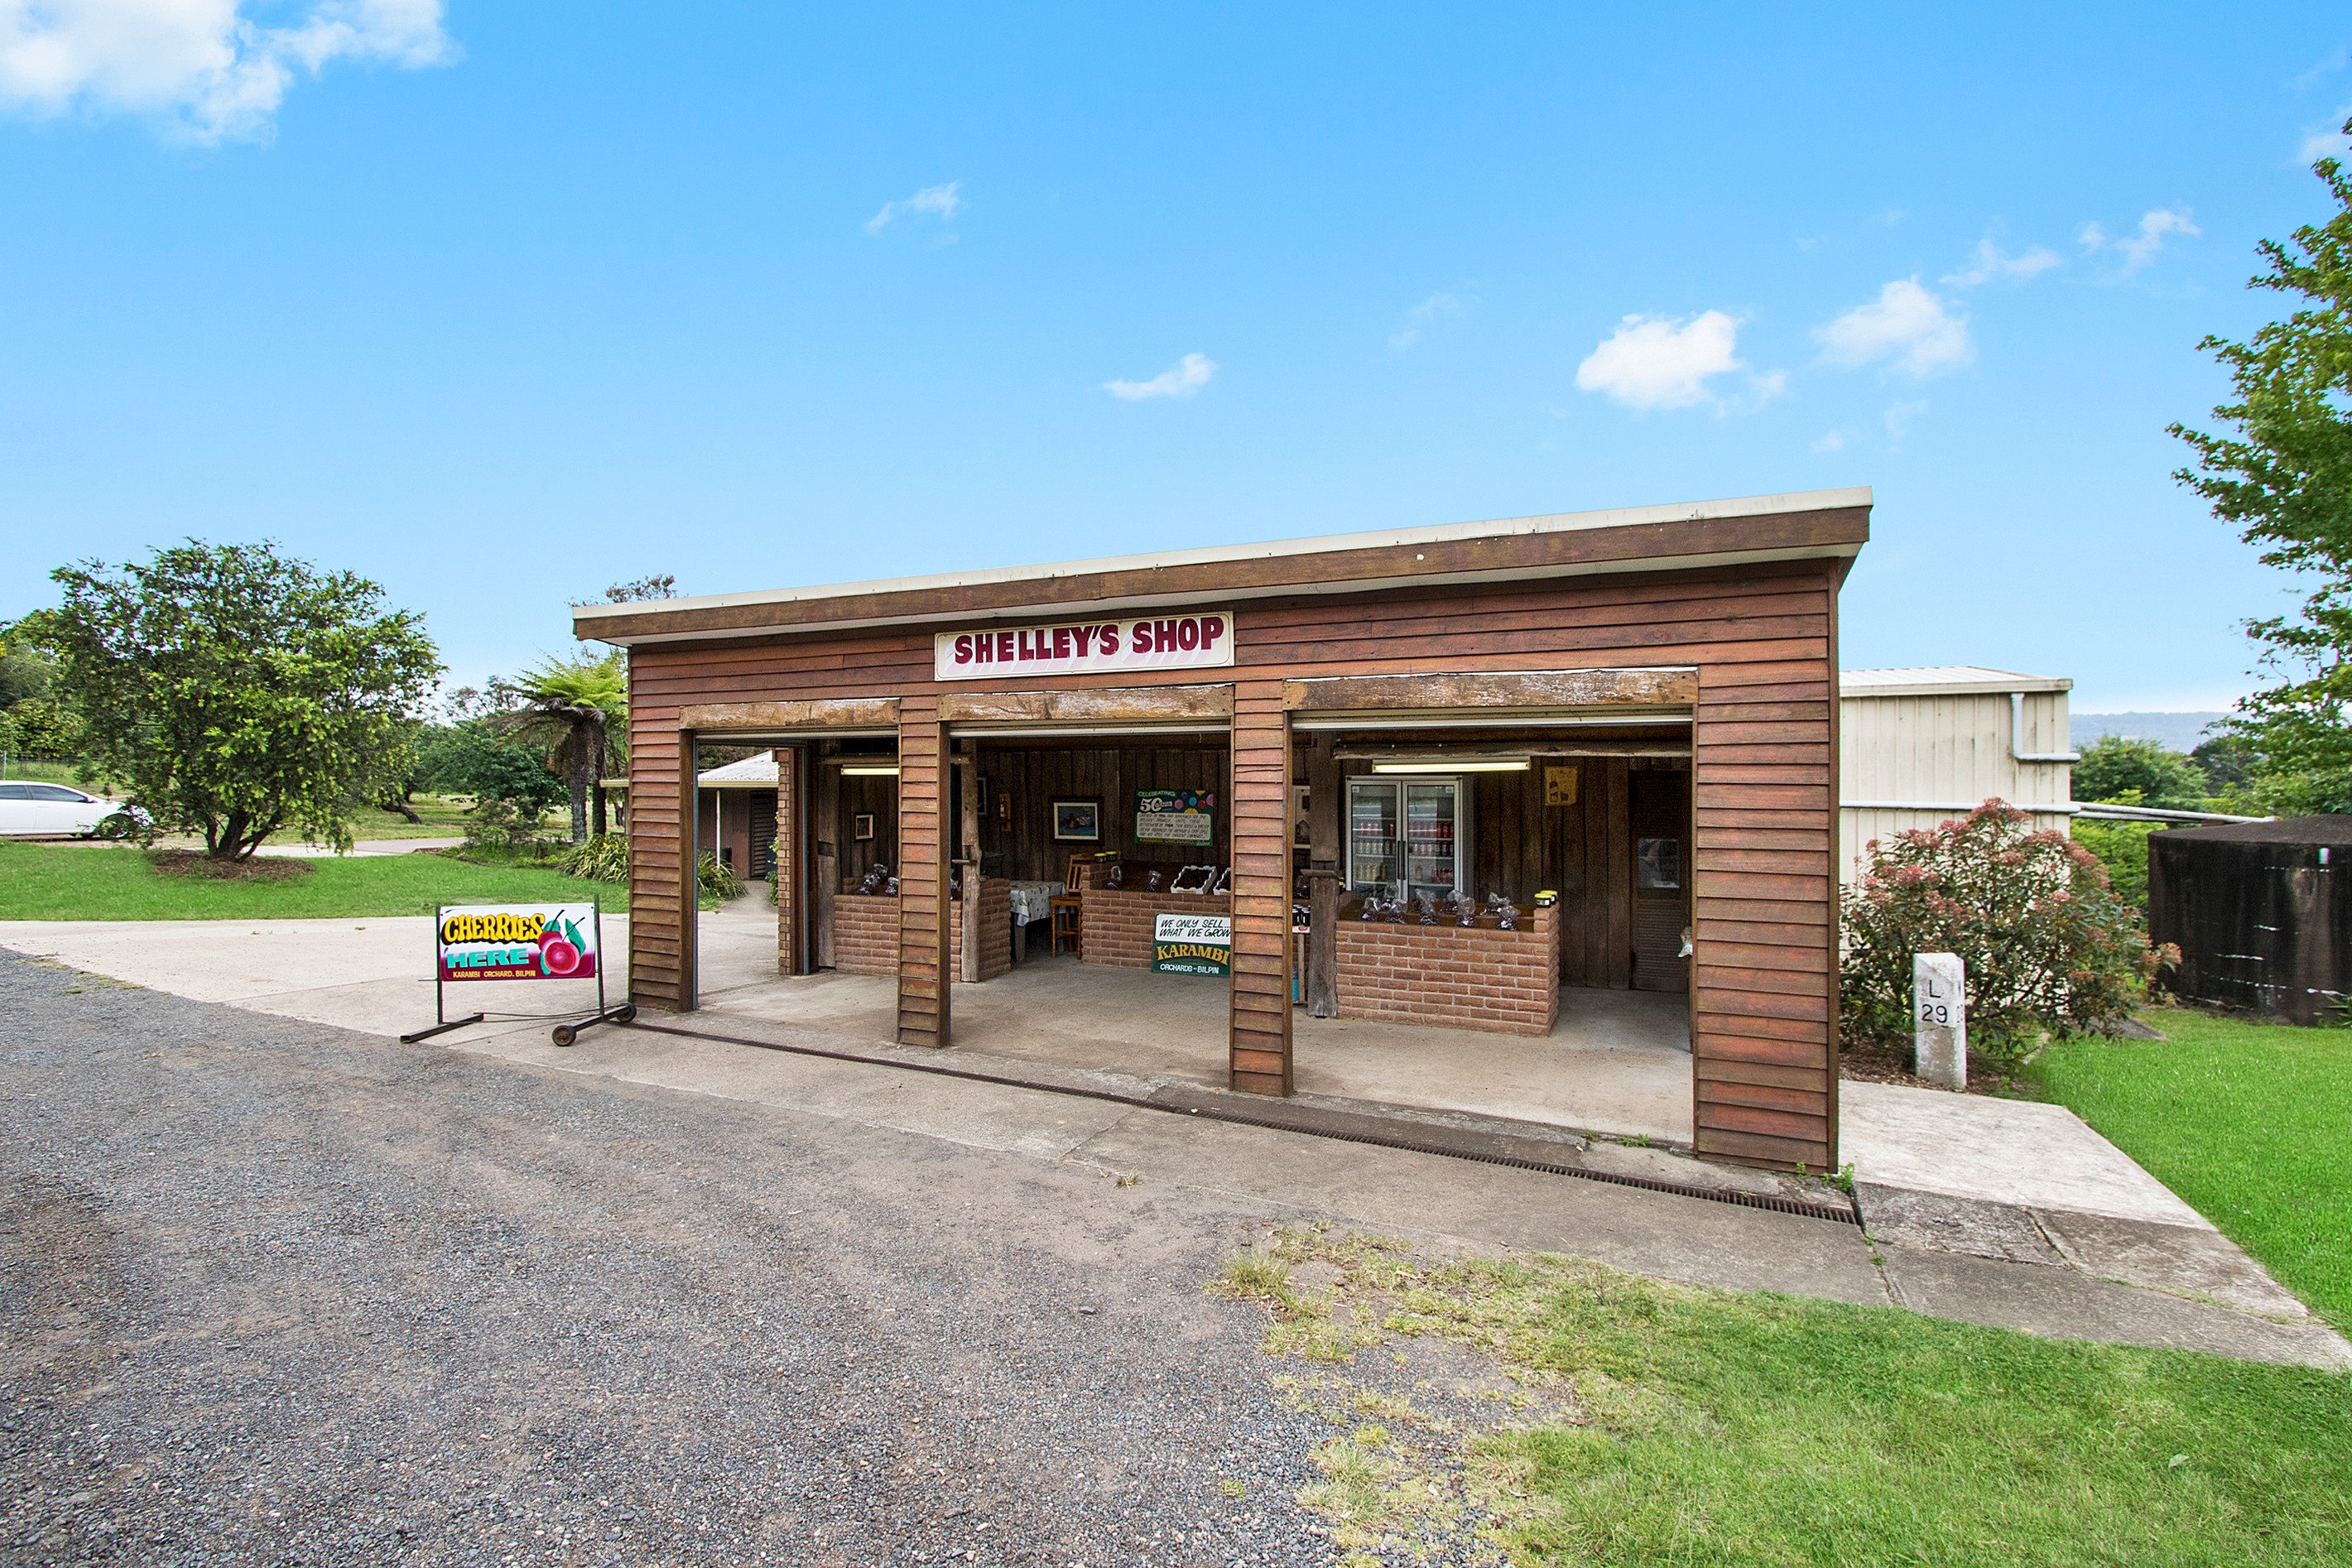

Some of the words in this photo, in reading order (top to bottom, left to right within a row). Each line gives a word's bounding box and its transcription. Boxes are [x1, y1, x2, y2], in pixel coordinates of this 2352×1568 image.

[955, 622, 1119, 664] SHELLEY'S
[1132, 617, 1224, 654] SHOP
[1140, 797, 1163, 811] 50
[442, 912, 546, 944] CHERRIES
[1159, 928, 1184, 937] WHAT
[1187, 928, 1204, 937] WE
[1204, 929, 1230, 937] GROW
[1161, 919, 1174, 928] WE
[1176, 919, 1199, 928] ONLY
[446, 948, 530, 969] HERE
[1157, 945, 1230, 965] KARAMBI
[1160, 964, 1192, 972] ORCHARDS
[1197, 965, 1219, 974] BILPIN
[1929, 979, 1941, 998] L
[1922, 1004, 1947, 1023] 29
